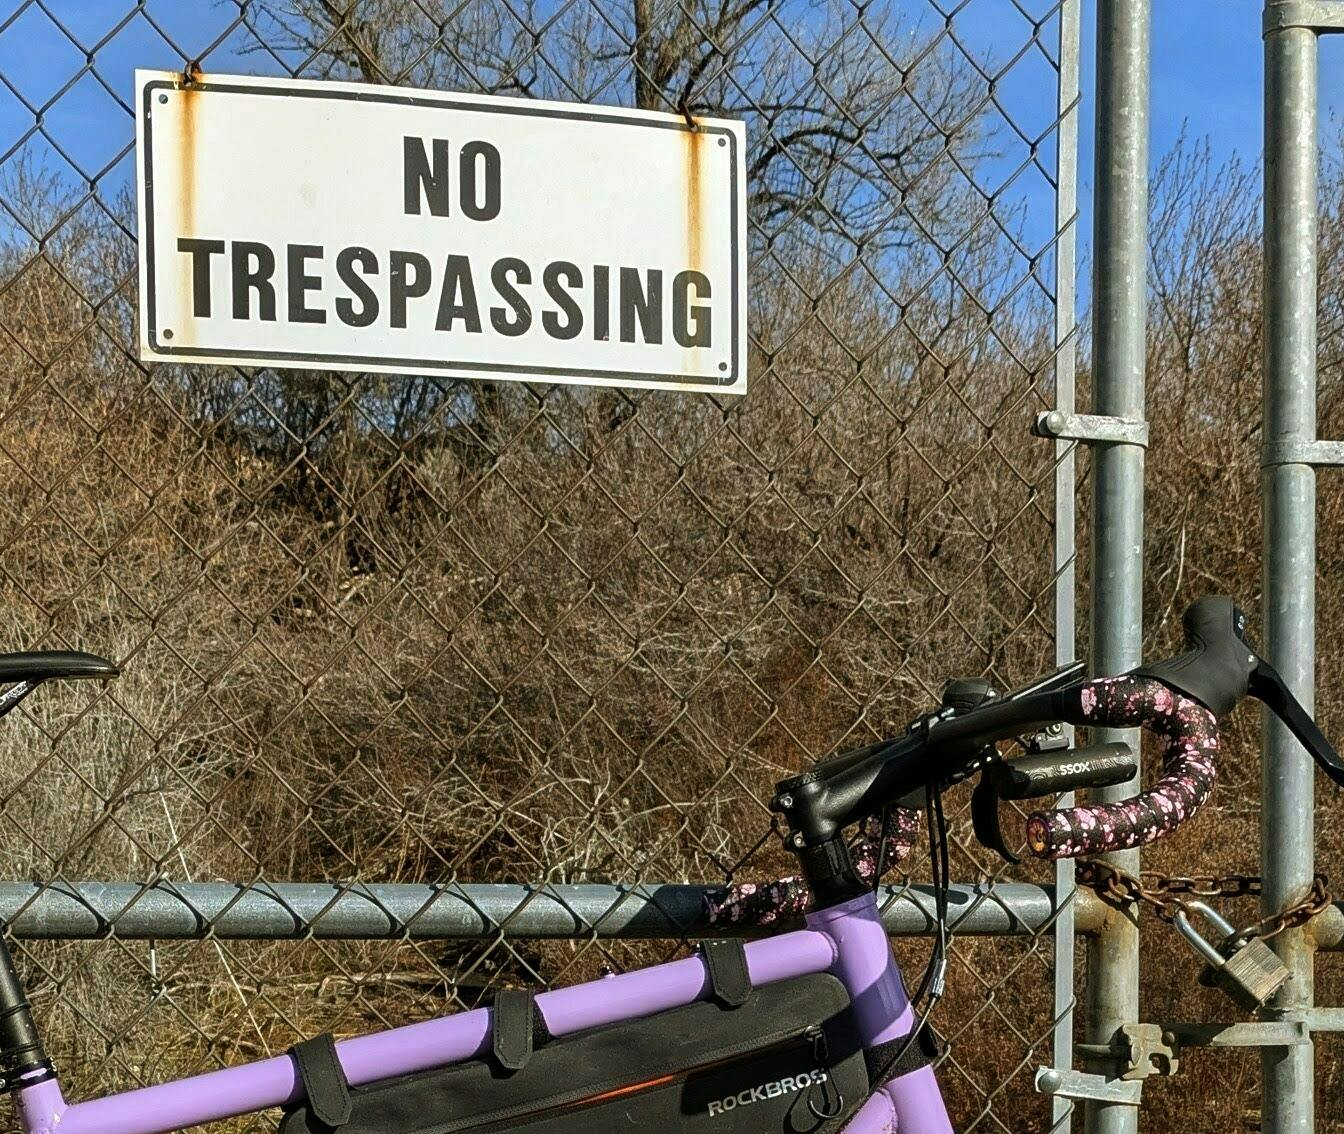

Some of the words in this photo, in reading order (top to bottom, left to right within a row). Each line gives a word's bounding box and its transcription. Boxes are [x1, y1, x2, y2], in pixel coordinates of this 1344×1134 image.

[403, 136, 501, 221] NO
[177, 238, 712, 349] TRESPASSING
[707, 1069, 828, 1117] ROCKBROS
